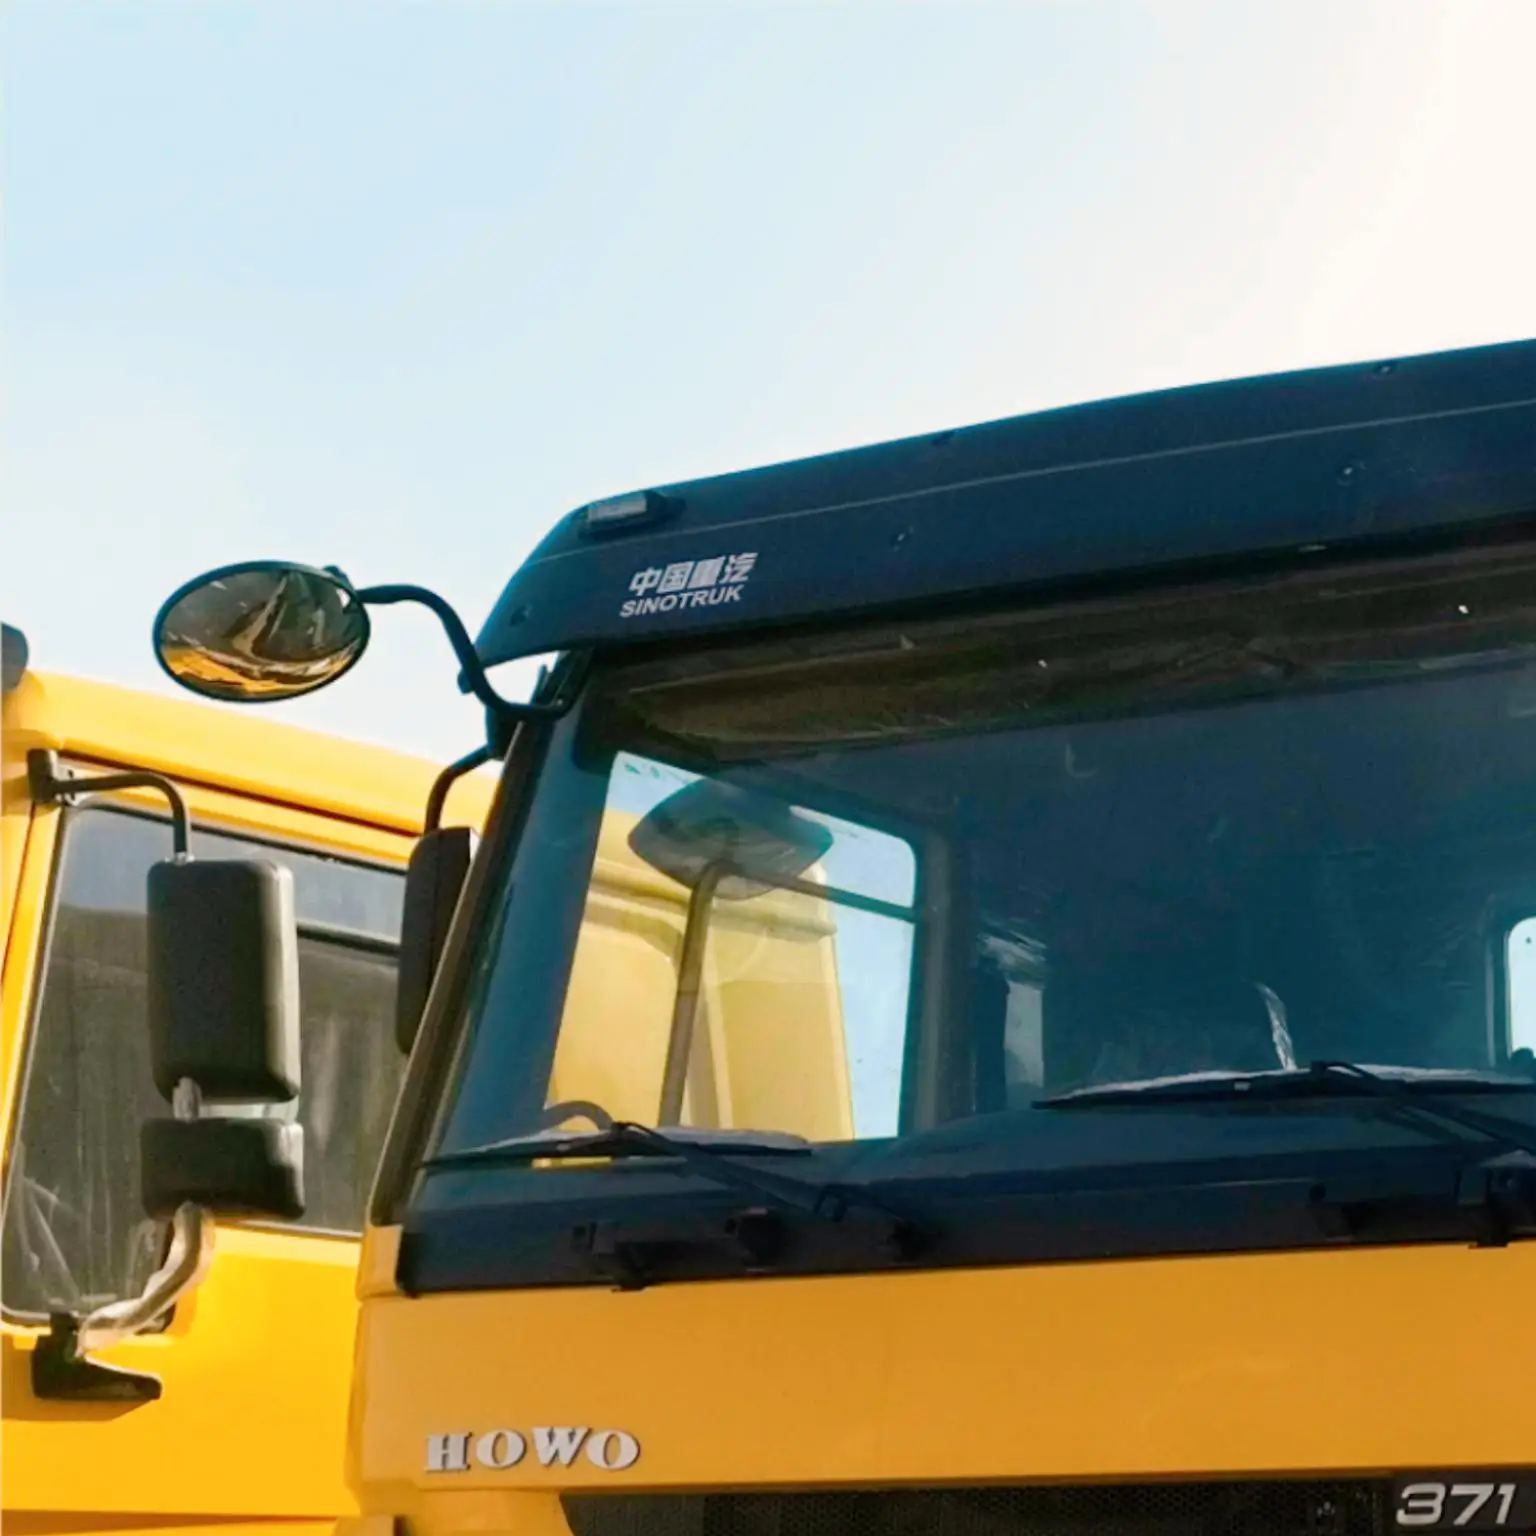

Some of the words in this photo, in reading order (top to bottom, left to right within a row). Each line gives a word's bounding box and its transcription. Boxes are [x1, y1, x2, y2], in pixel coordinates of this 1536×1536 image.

[619, 584, 744, 618] SINOTRUK
[424, 1426, 641, 1472] HOWO
[1396, 1482, 1516, 1526] 371
